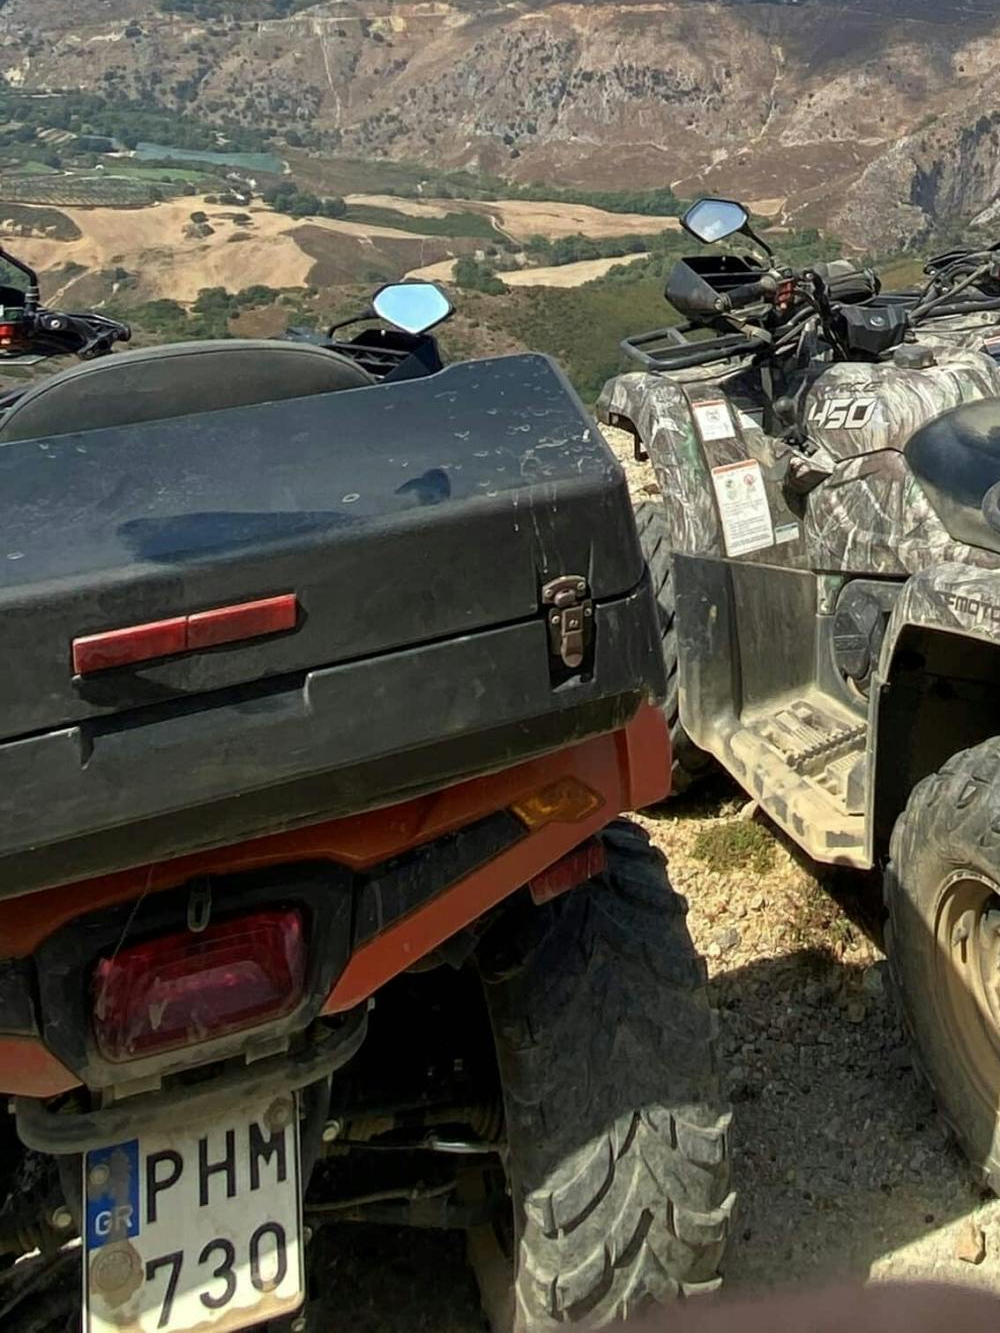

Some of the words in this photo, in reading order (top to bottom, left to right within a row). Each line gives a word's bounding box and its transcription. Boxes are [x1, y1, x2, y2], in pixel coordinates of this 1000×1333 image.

[808, 397, 877, 429] 450
[146, 1122, 287, 1225] PHM
[95, 1205, 133, 1236] GR
[145, 1221, 288, 1329] 730
